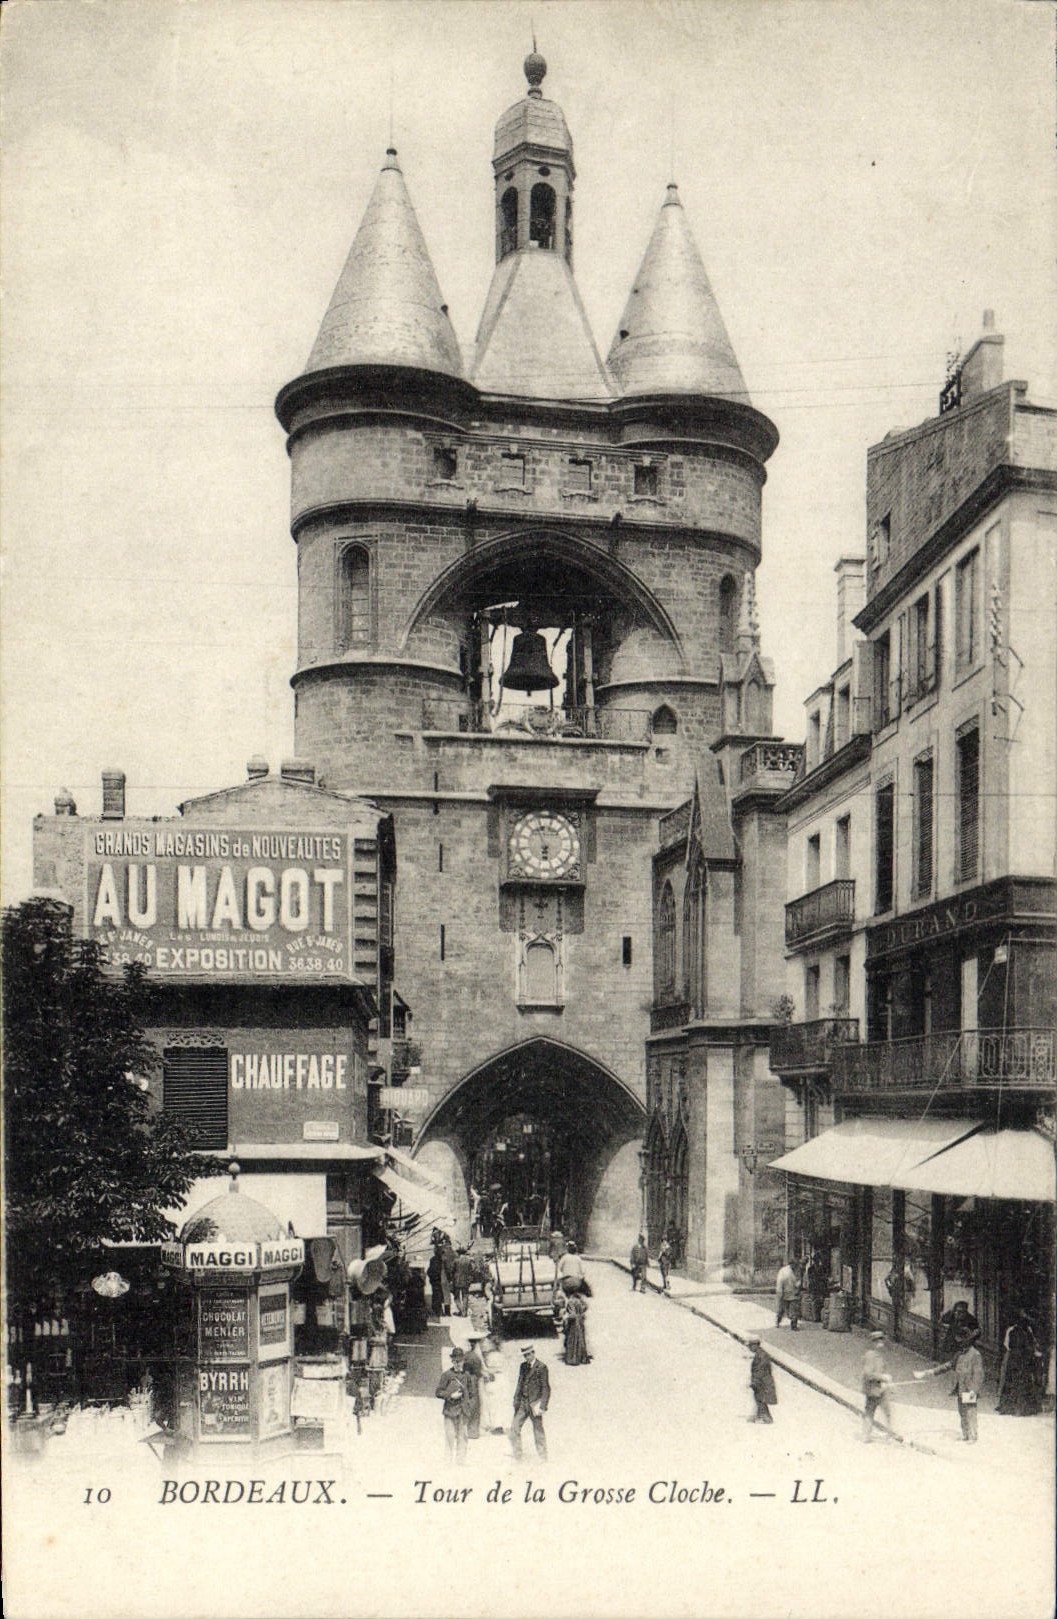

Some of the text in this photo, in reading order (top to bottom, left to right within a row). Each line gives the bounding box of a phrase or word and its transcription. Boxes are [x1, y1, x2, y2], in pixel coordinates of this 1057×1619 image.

[95, 831, 150, 856] GRANDS
[155, 832, 229, 858] MAGASINS
[233, 838, 249, 858] de
[93, 863, 344, 931] AU MAGOT
[286, 937, 306, 954] RUE
[156, 947, 282, 970] EXPOSITION
[231, 1054, 347, 1089] CHAUFFAGE
[190, 1251, 253, 1266] MAGGI
[264, 1247, 303, 1265] MAGGI
[202, 1311, 246, 1322] CHOCOLAT
[205, 1326, 245, 1337] MENIER
[200, 1371, 249, 1391] BYRRH
